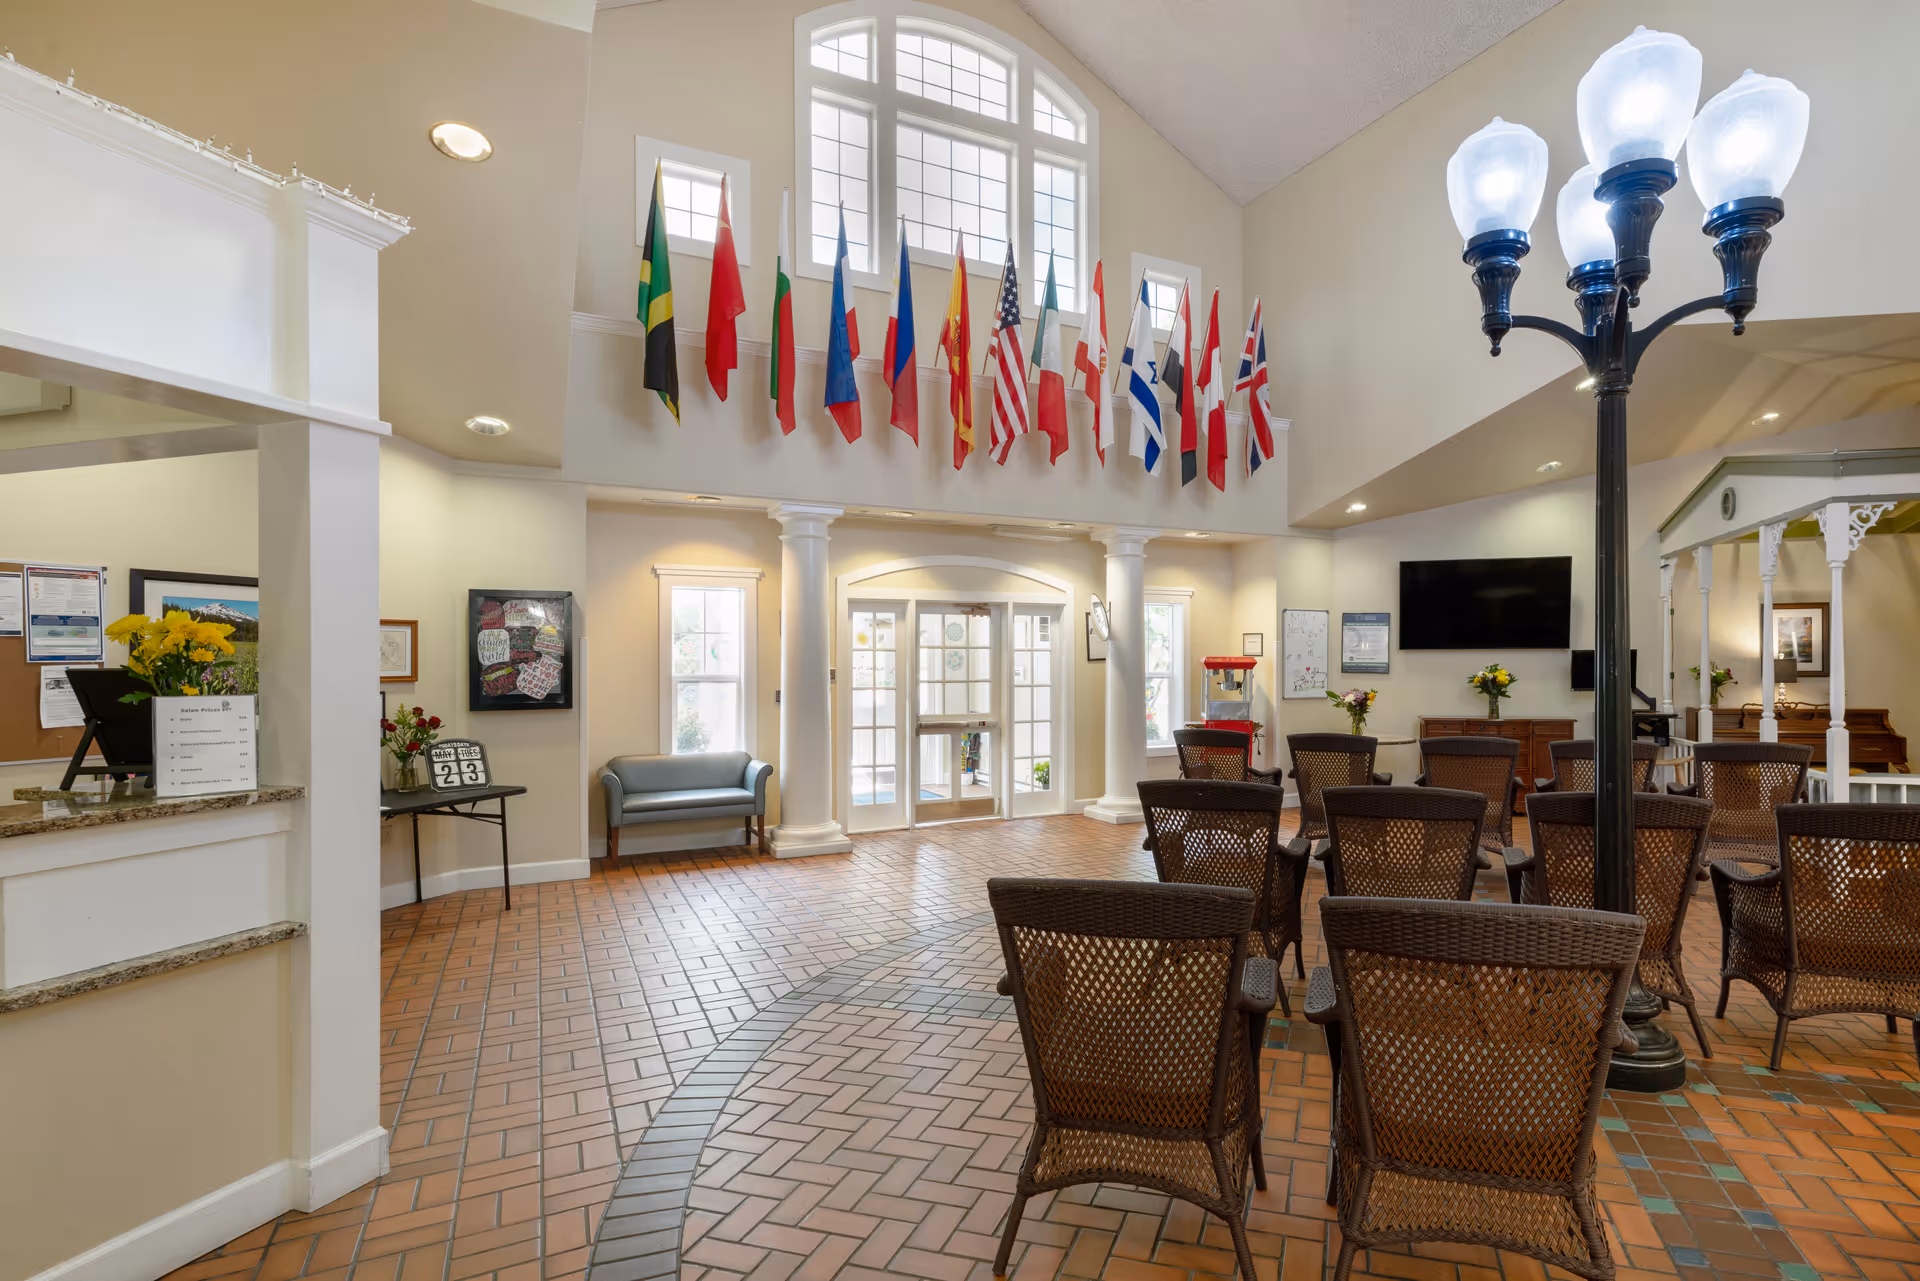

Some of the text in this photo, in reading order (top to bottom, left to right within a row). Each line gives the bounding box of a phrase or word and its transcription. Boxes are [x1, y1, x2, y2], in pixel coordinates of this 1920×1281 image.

[526, 661, 558, 681] BE YOU
[434, 749, 478, 759] MAY TUES
